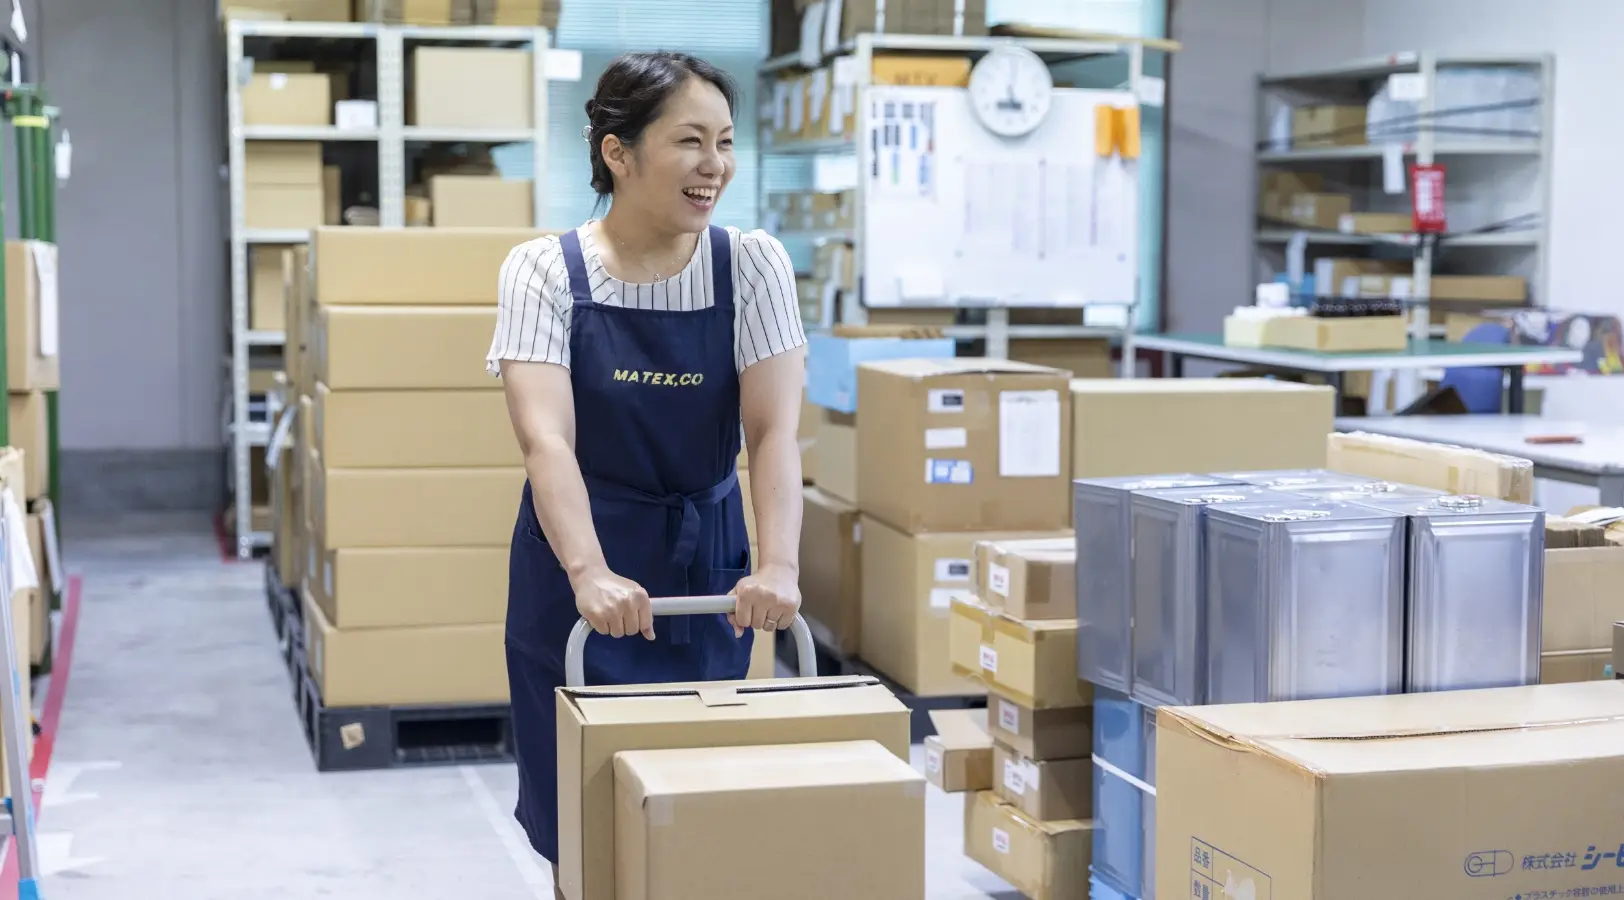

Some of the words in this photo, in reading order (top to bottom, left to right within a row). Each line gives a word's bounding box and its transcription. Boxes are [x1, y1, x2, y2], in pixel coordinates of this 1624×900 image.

[612, 368, 705, 388] MATEX,CO
[1193, 845, 1210, 869] 品番
[1521, 852, 1577, 871] 株式会社
